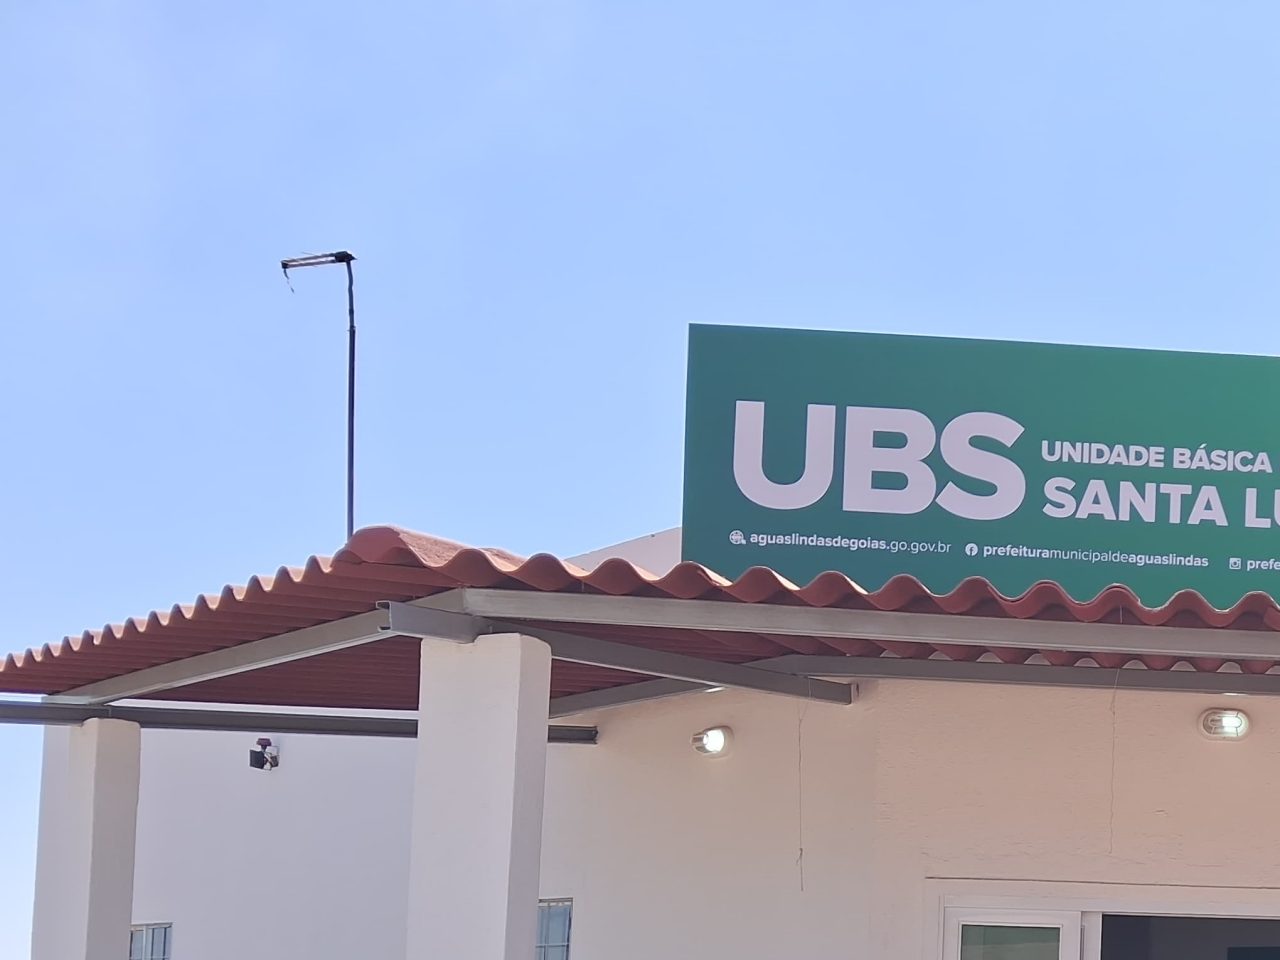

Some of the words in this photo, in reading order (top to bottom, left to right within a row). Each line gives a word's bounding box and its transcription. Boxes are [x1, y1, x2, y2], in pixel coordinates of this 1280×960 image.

[733, 400, 1027, 520] UBS
[1041, 440, 1165, 468] UNIDADE
[1172, 443, 1273, 474] BÁSICA
[1042, 476, 1229, 526] SANTA
[749, 532, 952, 555] aguaslindasdegoias.go.gov.br
[982, 543, 1209, 567] prefeituramunicipaldeaguaslindas
